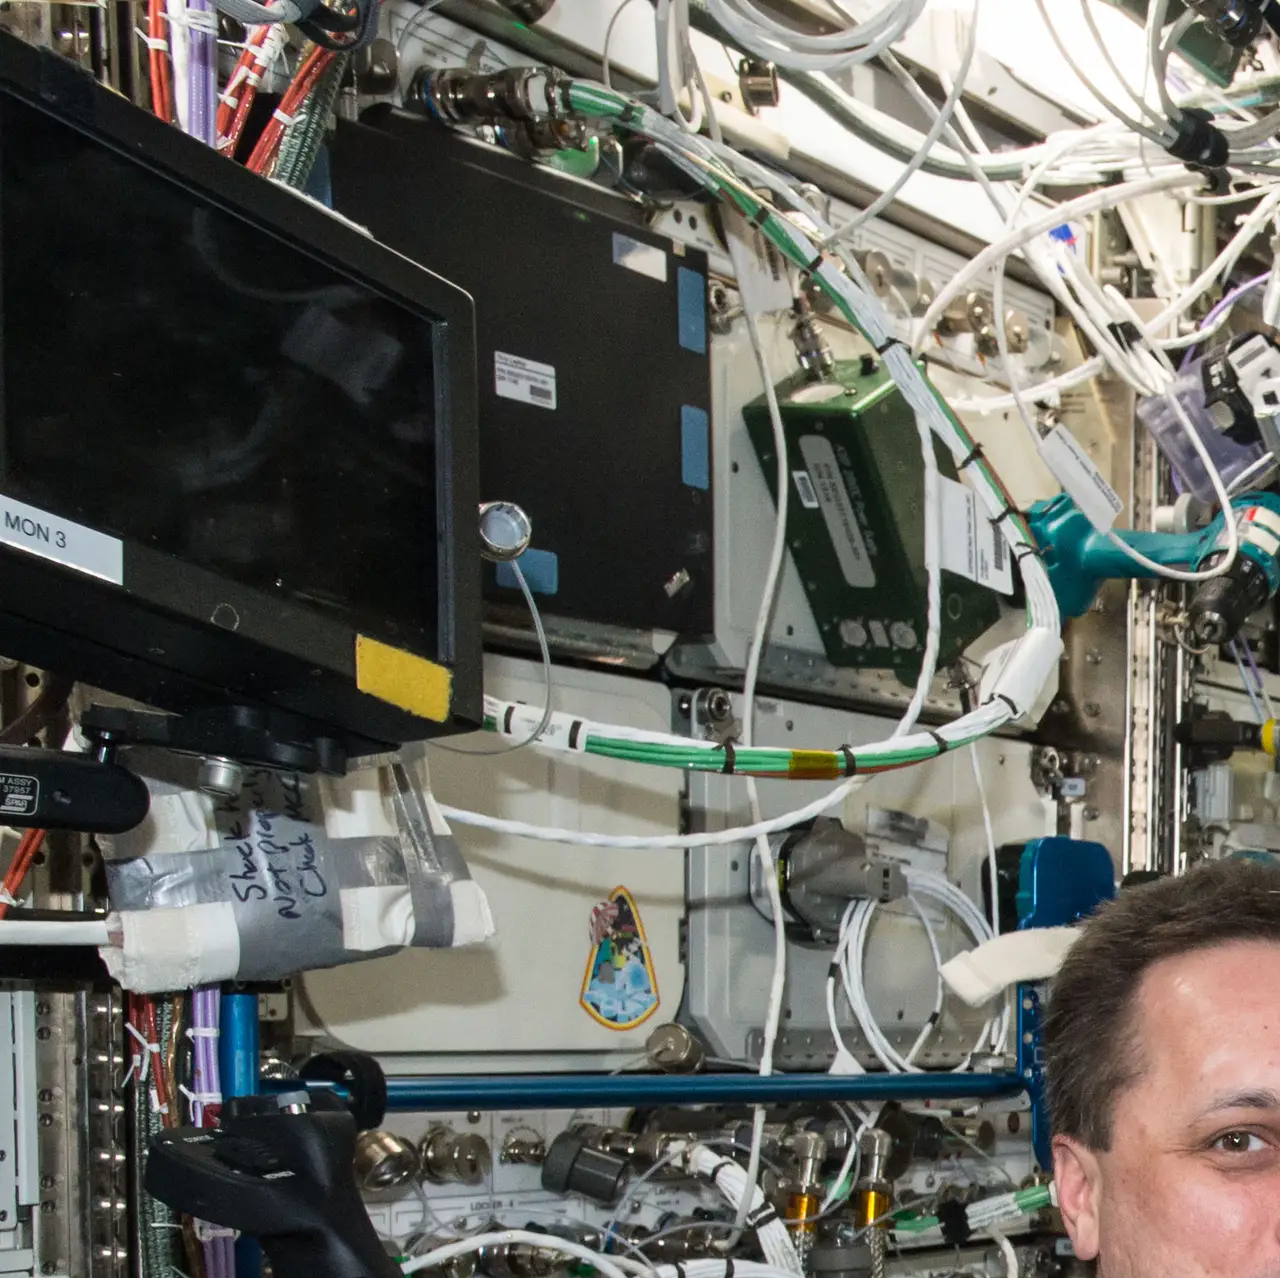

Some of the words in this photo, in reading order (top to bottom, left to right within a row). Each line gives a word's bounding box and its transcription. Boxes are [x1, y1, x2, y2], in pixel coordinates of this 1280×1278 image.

[5, 511, 49, 542] MON
[55, 531, 66, 548] 3
[8, 779, 32, 787] ASSY
[4, 798, 28, 807] SPAR
